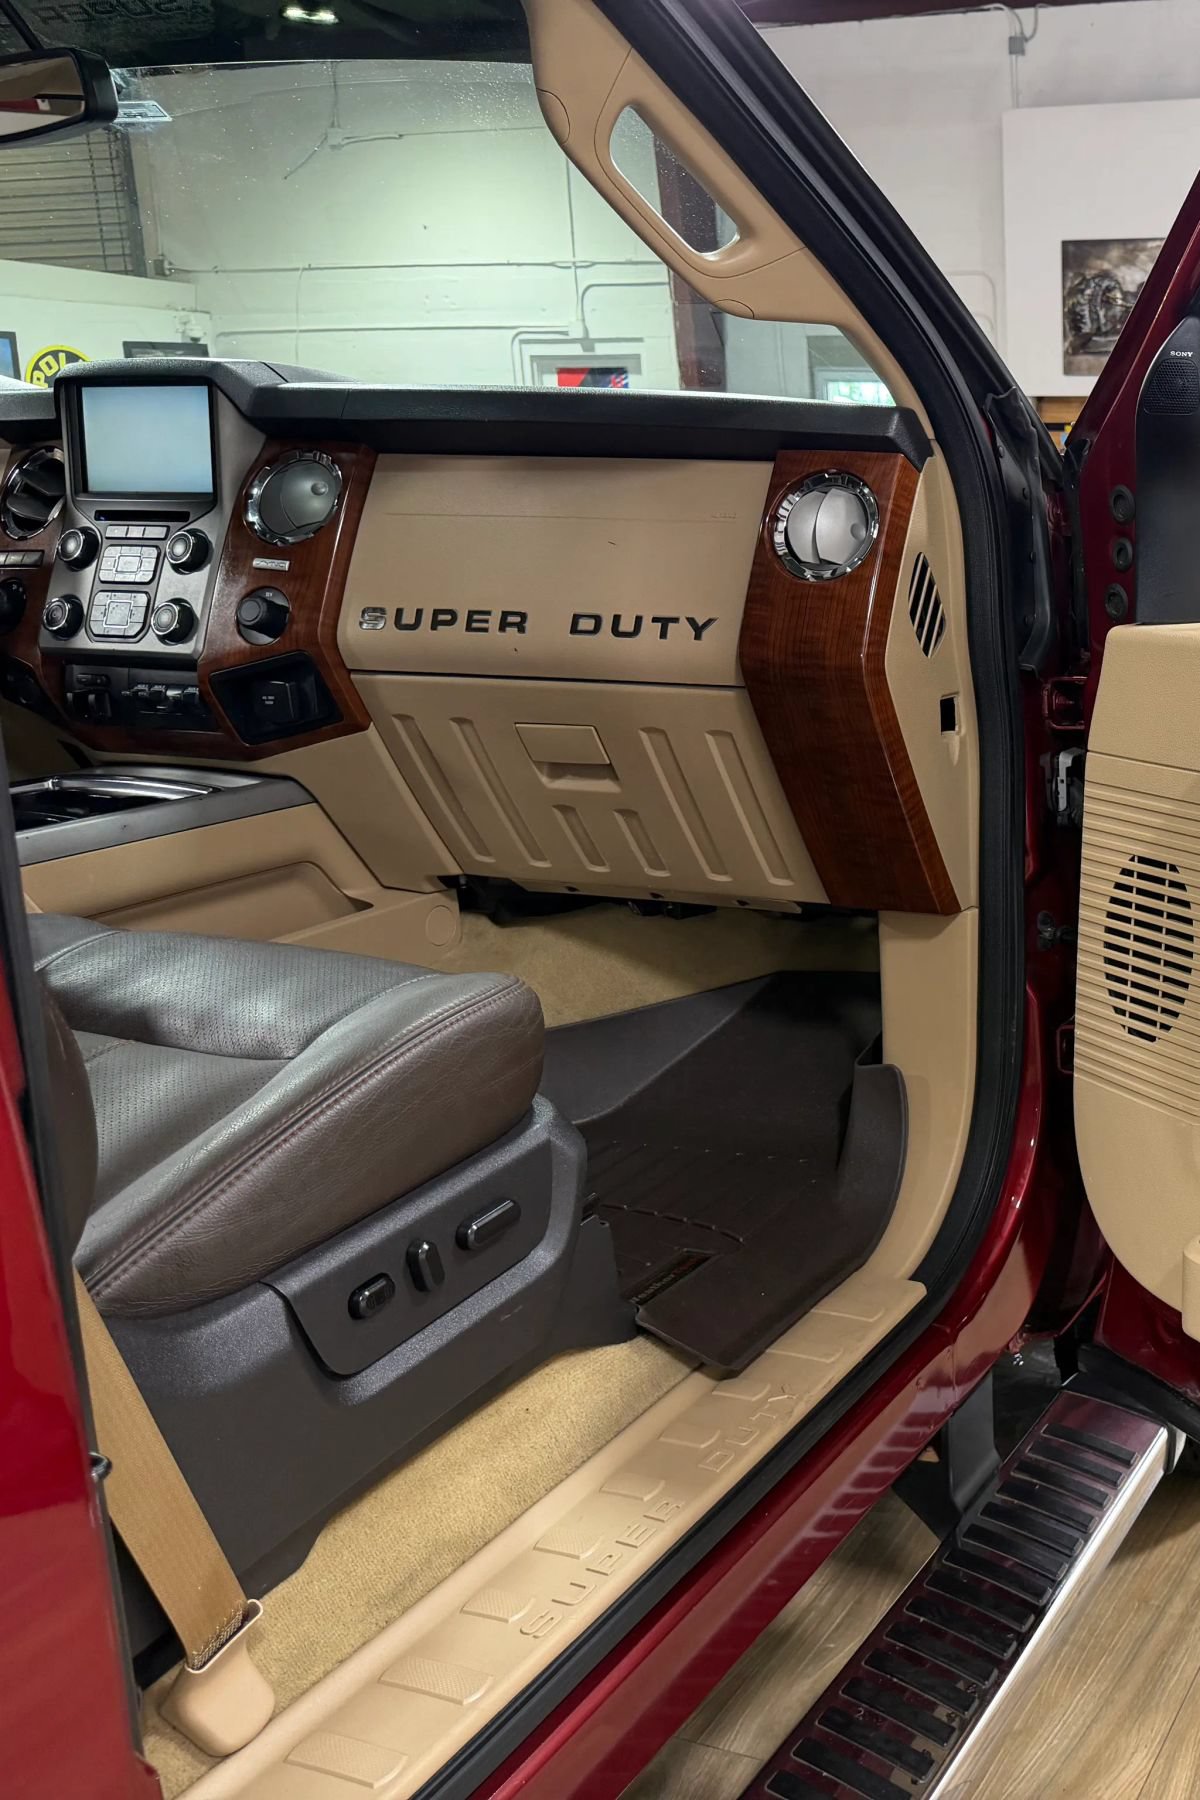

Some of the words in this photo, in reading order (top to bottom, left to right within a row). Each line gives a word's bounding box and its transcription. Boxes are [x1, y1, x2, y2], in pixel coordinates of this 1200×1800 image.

[1169, 350, 1194, 358] SONY
[357, 605, 529, 634] SUPER
[569, 613, 720, 641] DUTY
[519, 1499, 683, 1639] SUPER
[698, 1382, 801, 1473] DUTY
